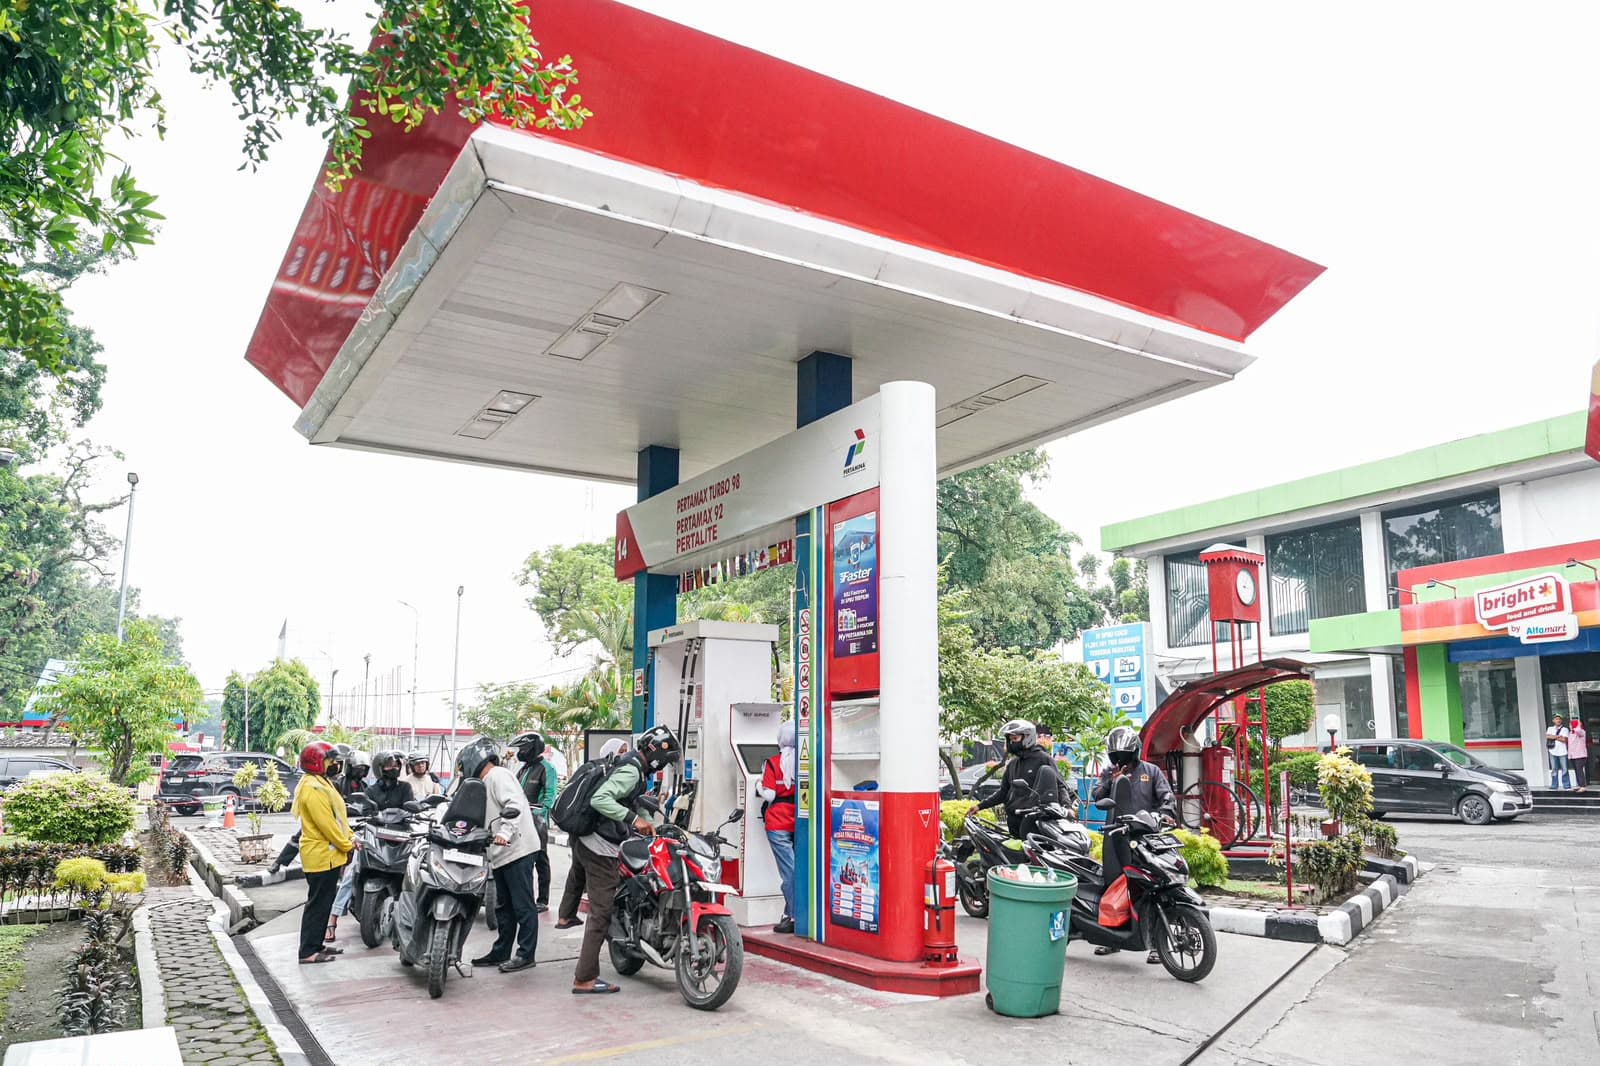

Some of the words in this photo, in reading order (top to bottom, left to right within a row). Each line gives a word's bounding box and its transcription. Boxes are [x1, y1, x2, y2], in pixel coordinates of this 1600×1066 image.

[676, 487, 708, 515] PERTAMAX
[709, 478, 731, 501] TURBO
[731, 472, 741, 491] 98
[676, 506, 713, 536] PERTAMAX
[714, 503, 724, 520] 92
[617, 537, 627, 561] 14
[676, 524, 718, 554] PERTALITE
[840, 567, 872, 583] Faster
[1483, 586, 1535, 611] bright
[1506, 610, 1522, 621] food
[1522, 607, 1537, 617] and
[1537, 603, 1557, 614] drink
[1511, 624, 1521, 633] by
[1526, 623, 1567, 635] Alfamart
